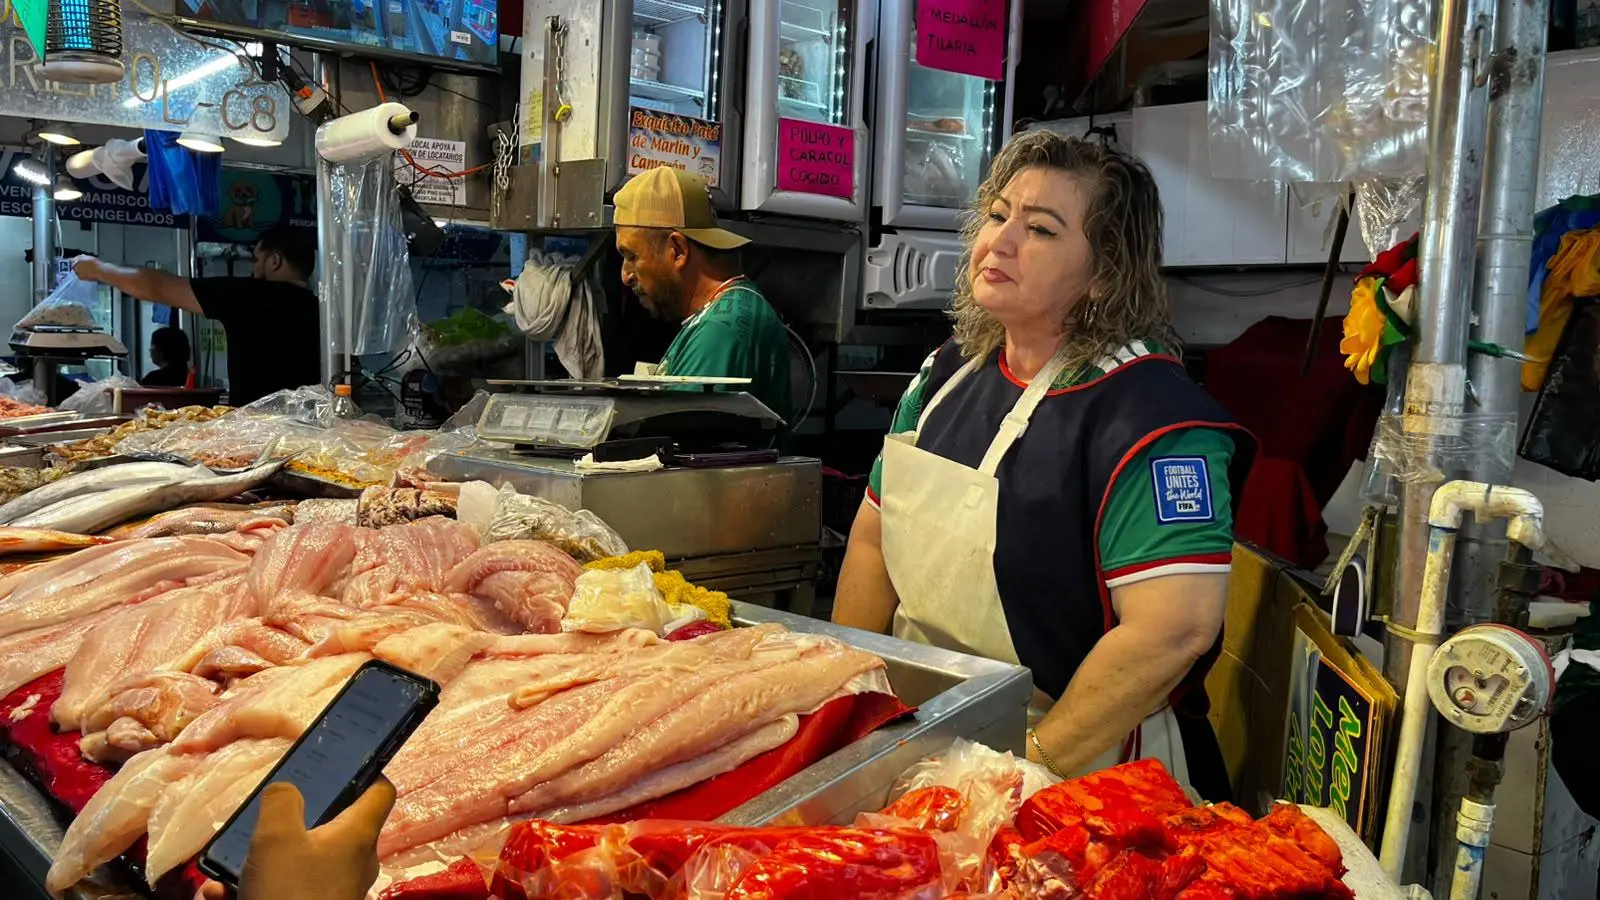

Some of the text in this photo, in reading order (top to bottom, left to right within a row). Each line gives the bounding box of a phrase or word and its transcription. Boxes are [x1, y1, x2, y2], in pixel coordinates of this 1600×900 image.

[633, 110, 689, 137] Exquisito
[790, 127, 846, 148] PULPO Y
[411, 140, 430, 150] LOCAL
[431, 141, 451, 151] APOYA
[631, 134, 648, 149] de
[691, 145, 702, 161] y
[417, 149, 426, 158] DE
[427, 150, 463, 161] LOCATARIOS
[790, 147, 850, 166] CARACOL
[79, 191, 150, 207] MARISCO
[58, 206, 68, 217] Y
[71, 206, 175, 226] CONGELADOS
[1163, 465, 1197, 475] FOOTBALL
[1165, 475, 1199, 489] UNITES
[1165, 488, 1203, 501] the World
[1178, 502, 1194, 510] FIFA
